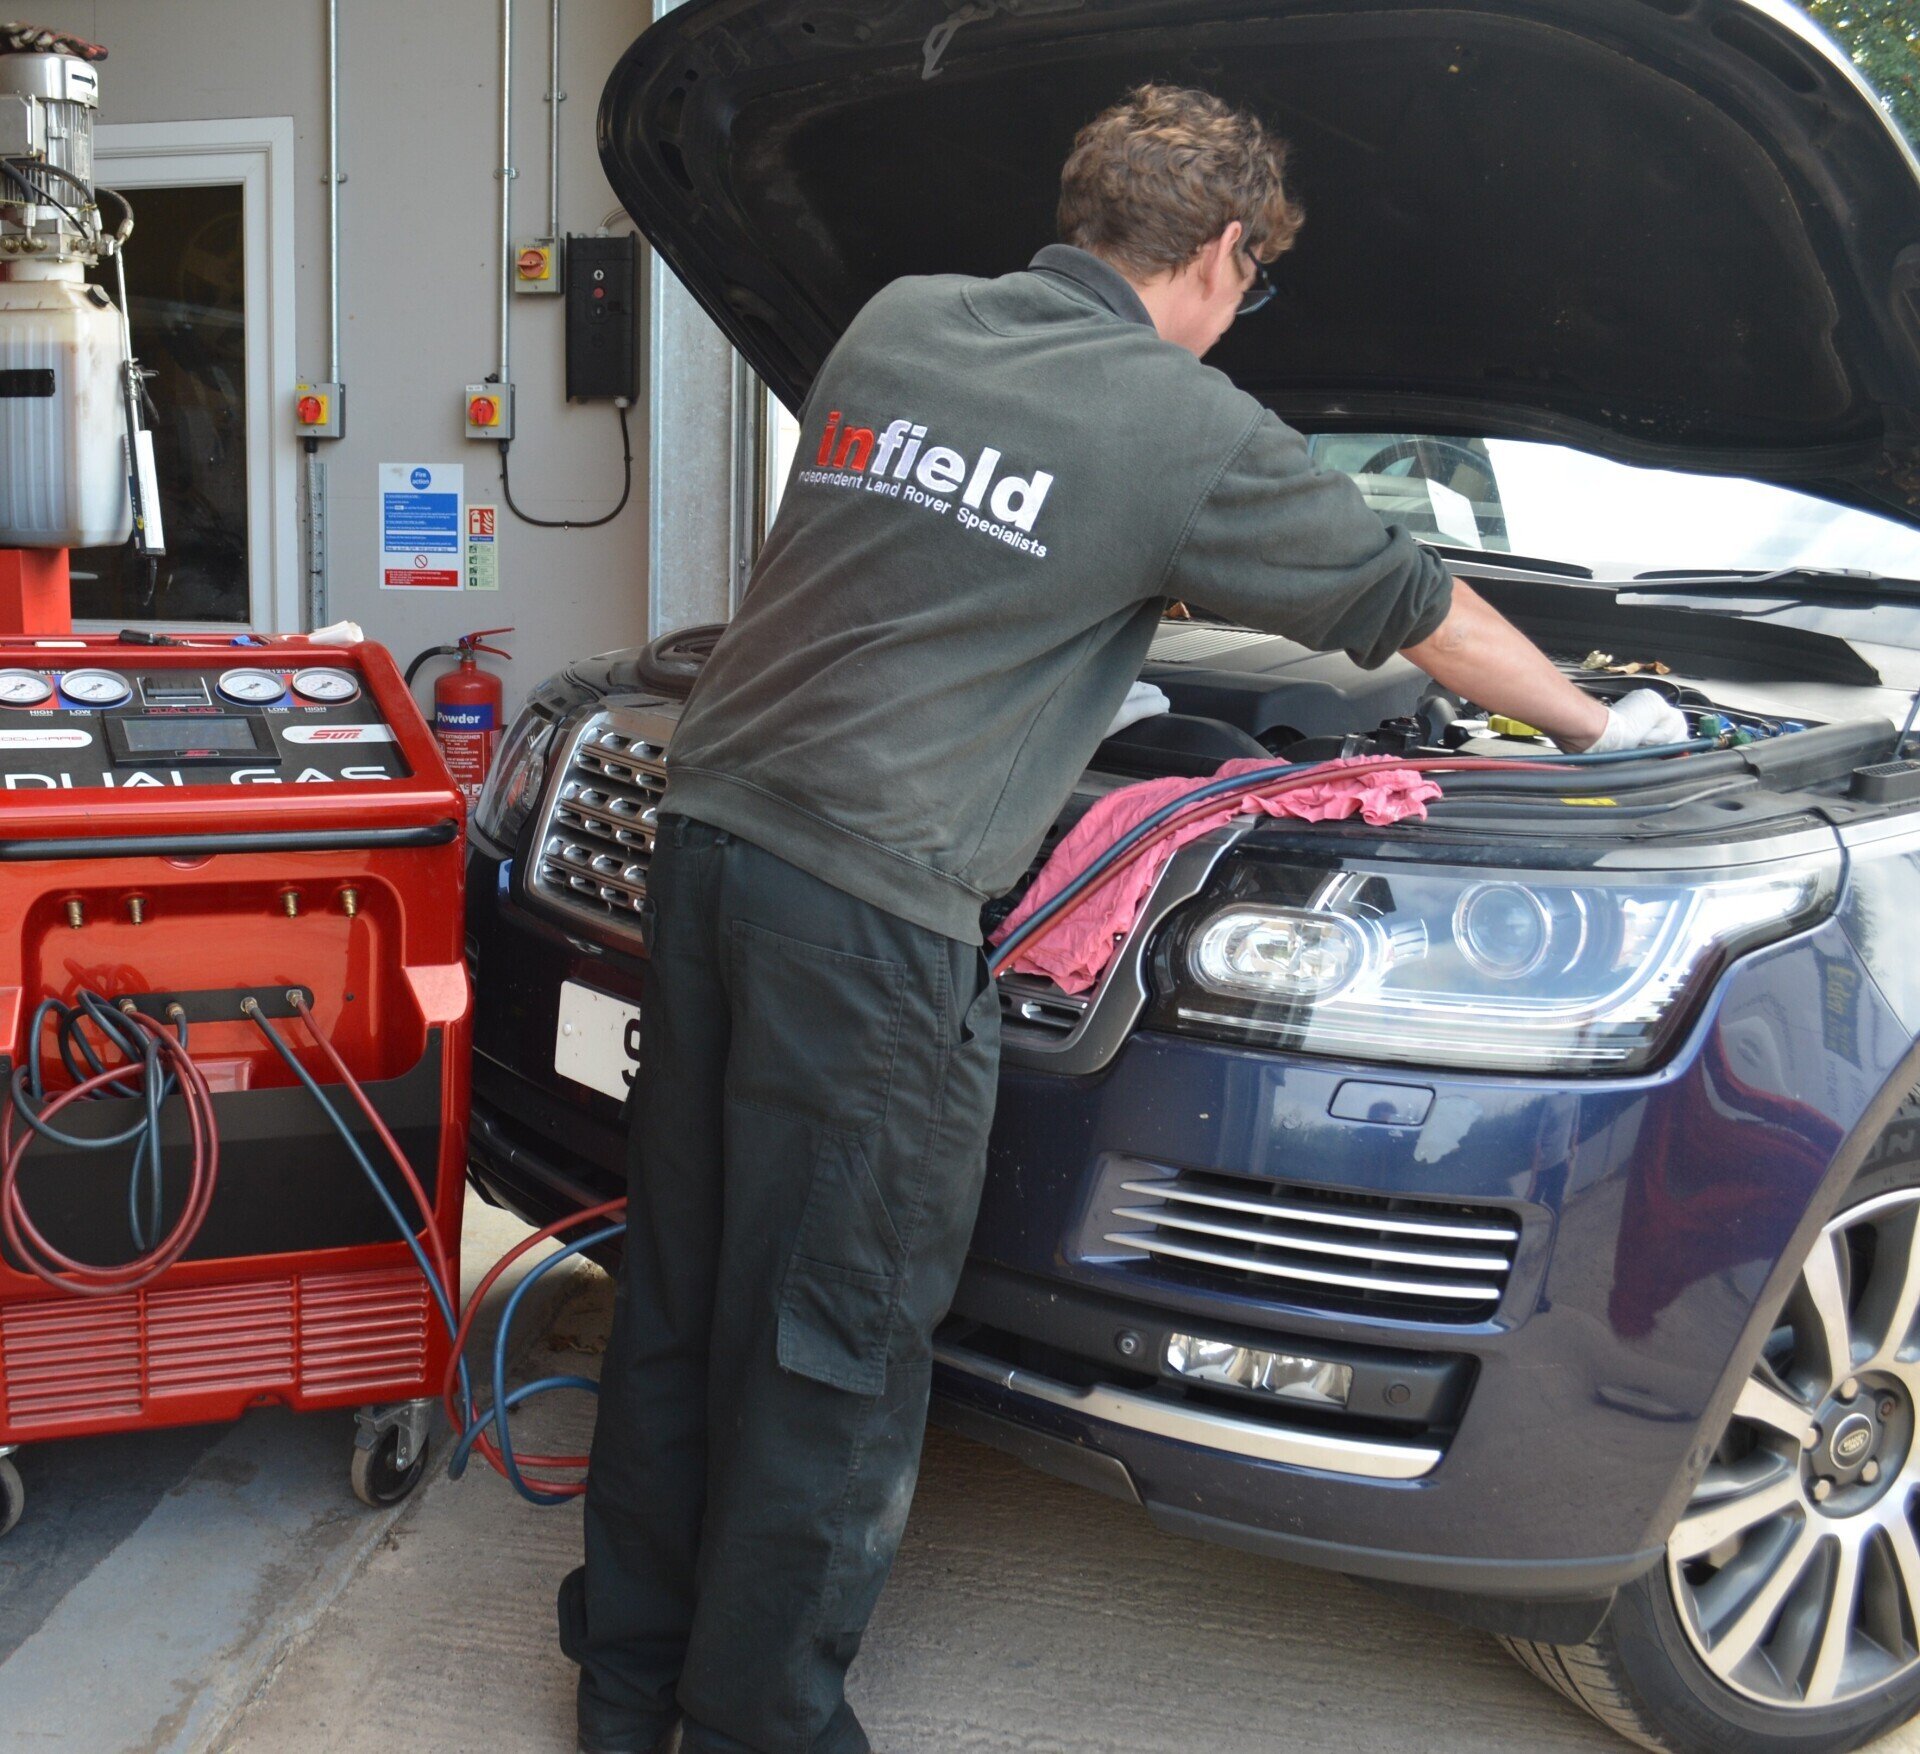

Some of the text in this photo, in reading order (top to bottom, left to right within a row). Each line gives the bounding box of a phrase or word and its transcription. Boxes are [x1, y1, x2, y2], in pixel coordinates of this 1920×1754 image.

[799, 469, 1048, 559] ndependent Land Rover Specialists
[816, 411, 1054, 533] infield
[437, 711, 481, 724] Powder
